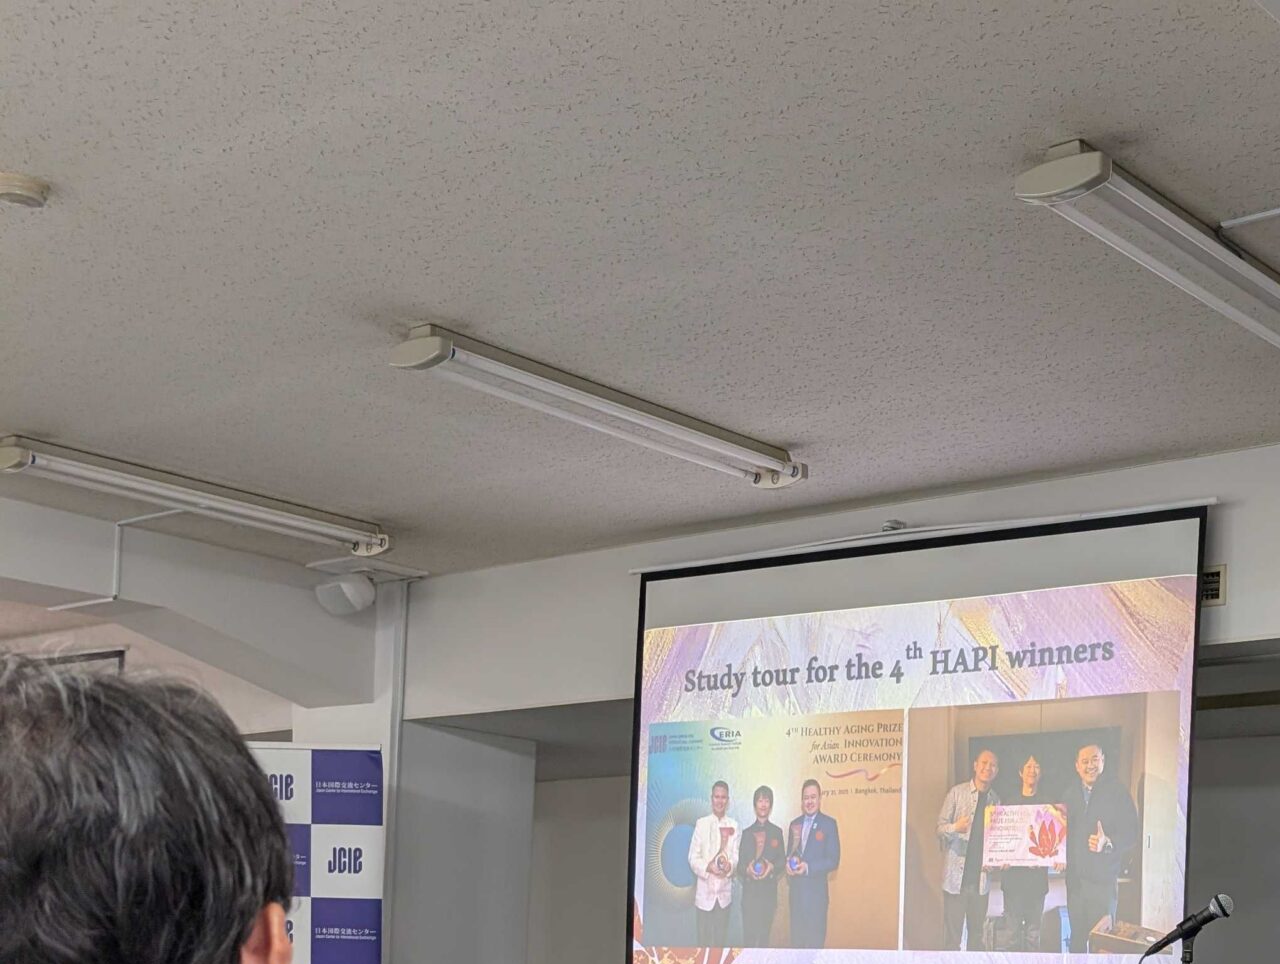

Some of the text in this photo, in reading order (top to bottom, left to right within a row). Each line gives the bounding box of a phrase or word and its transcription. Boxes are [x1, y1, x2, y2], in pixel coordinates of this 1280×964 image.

[684, 664, 747, 697] Study
[752, 665, 800, 688] tour
[805, 656, 839, 683] for
[845, 652, 883, 680] the
[929, 645, 999, 676] HAPI
[1005, 641, 1114, 669] winners
[800, 726, 841, 737] HEALTHY
[844, 724, 874, 735] AGING
[877, 722, 903, 733] PRIZE
[844, 737, 903, 748] INNOVATION
[813, 752, 903, 764] AWARD CEREMONY
[269, 774, 294, 800] CIE
